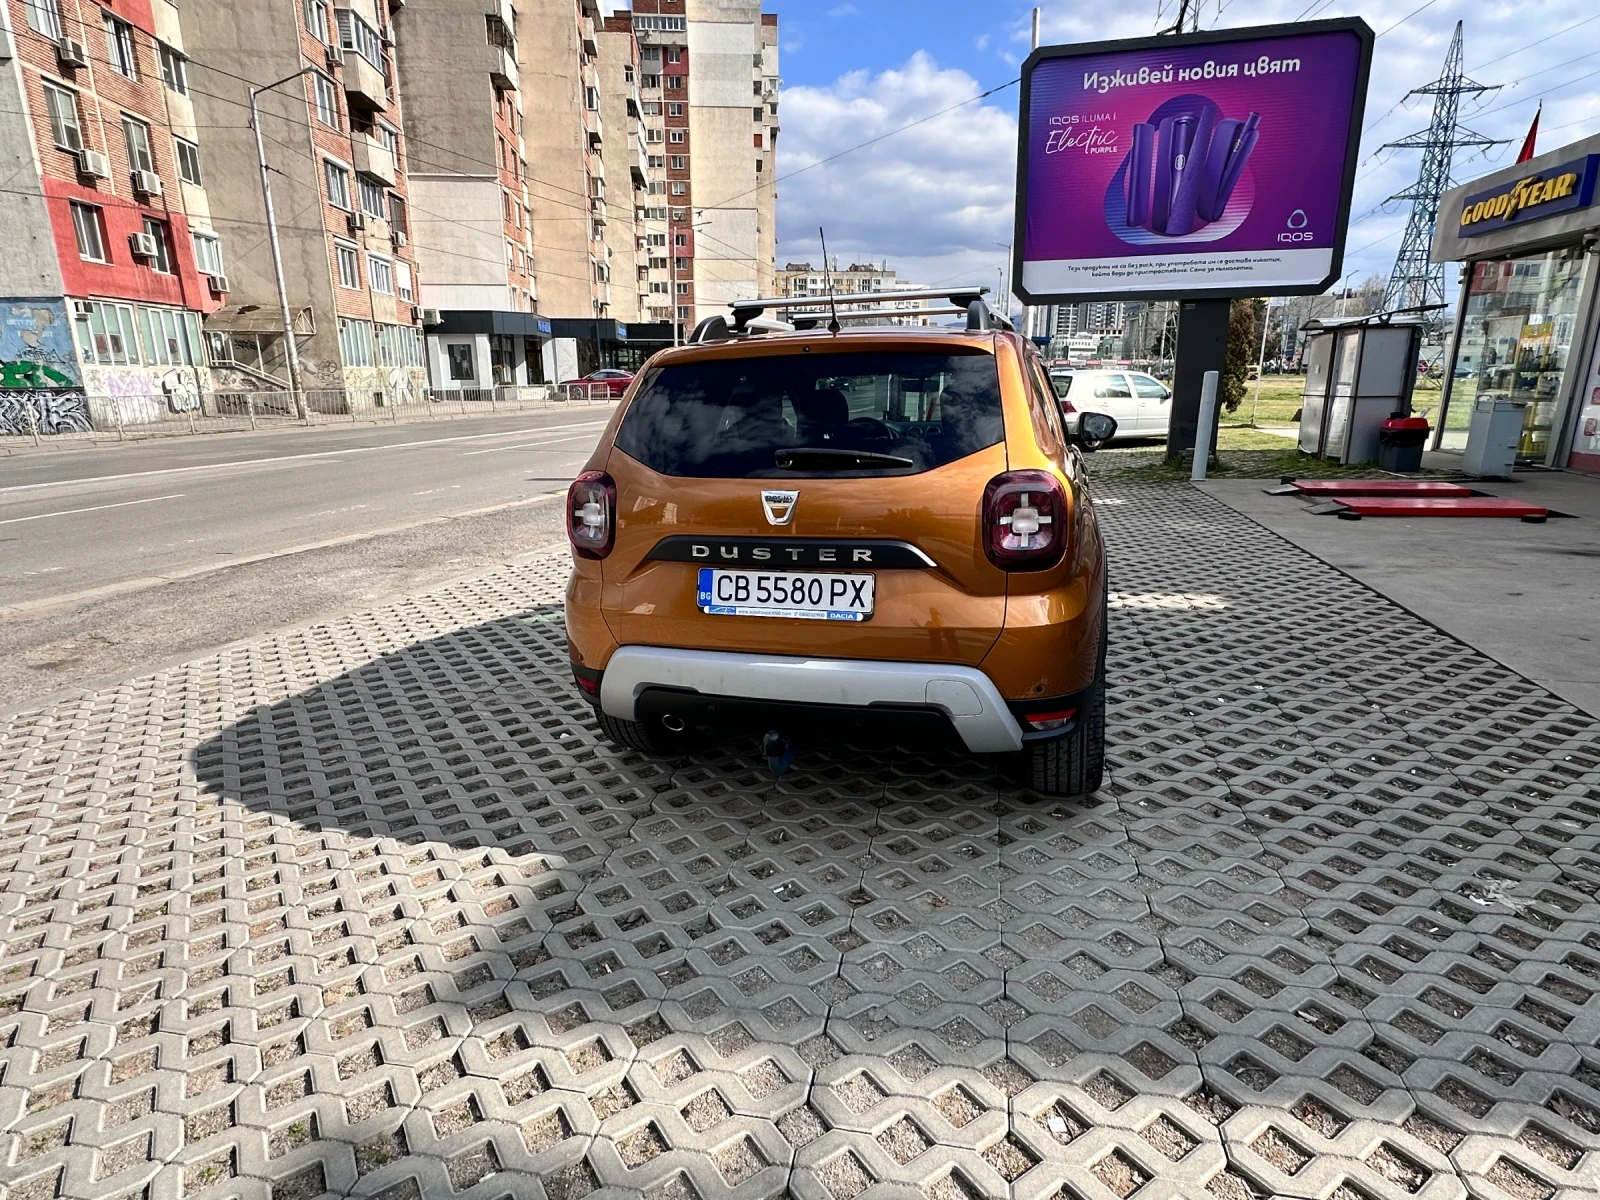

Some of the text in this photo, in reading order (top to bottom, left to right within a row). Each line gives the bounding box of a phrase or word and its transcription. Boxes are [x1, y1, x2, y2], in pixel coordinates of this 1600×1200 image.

[1083, 56, 1300, 93] Изживей новия цвят
[1049, 115, 1079, 125] IQOS
[1081, 113, 1111, 122] ILUMA
[1045, 125, 1118, 154] Electric
[1090, 146, 1117, 154] PURPLE
[1277, 232, 1313, 242] IQOS
[691, 545, 872, 562] DUSTER
[700, 591, 711, 600] BG
[717, 575, 867, 608] CB 5580 PX
